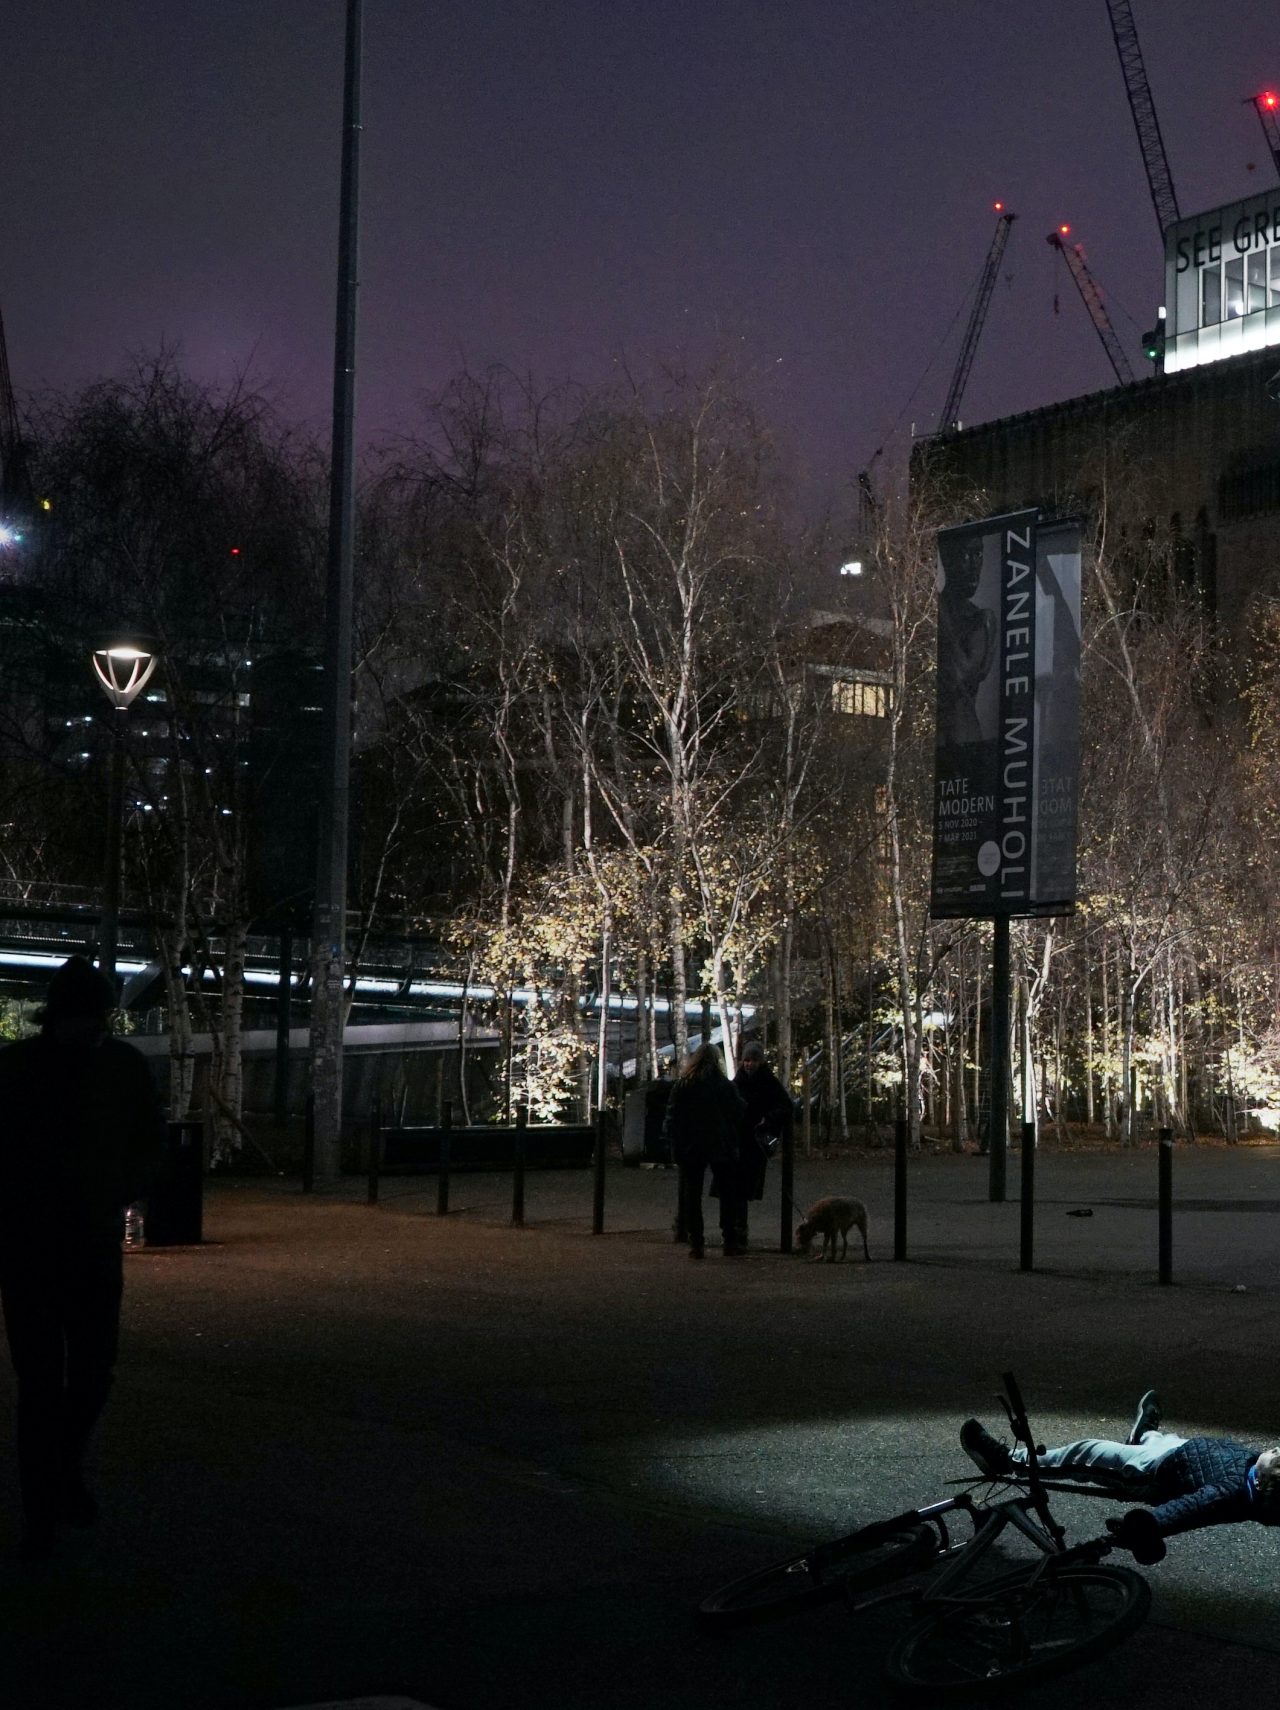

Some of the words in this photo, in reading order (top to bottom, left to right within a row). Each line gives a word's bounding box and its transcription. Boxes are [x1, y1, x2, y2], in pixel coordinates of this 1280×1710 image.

[1176, 226, 1221, 273] SEE
[1006, 526, 1031, 697] ZANELE
[939, 778, 969, 796] TATE
[939, 794, 995, 816] MODERN
[1000, 717, 1029, 900] MUHOLI
